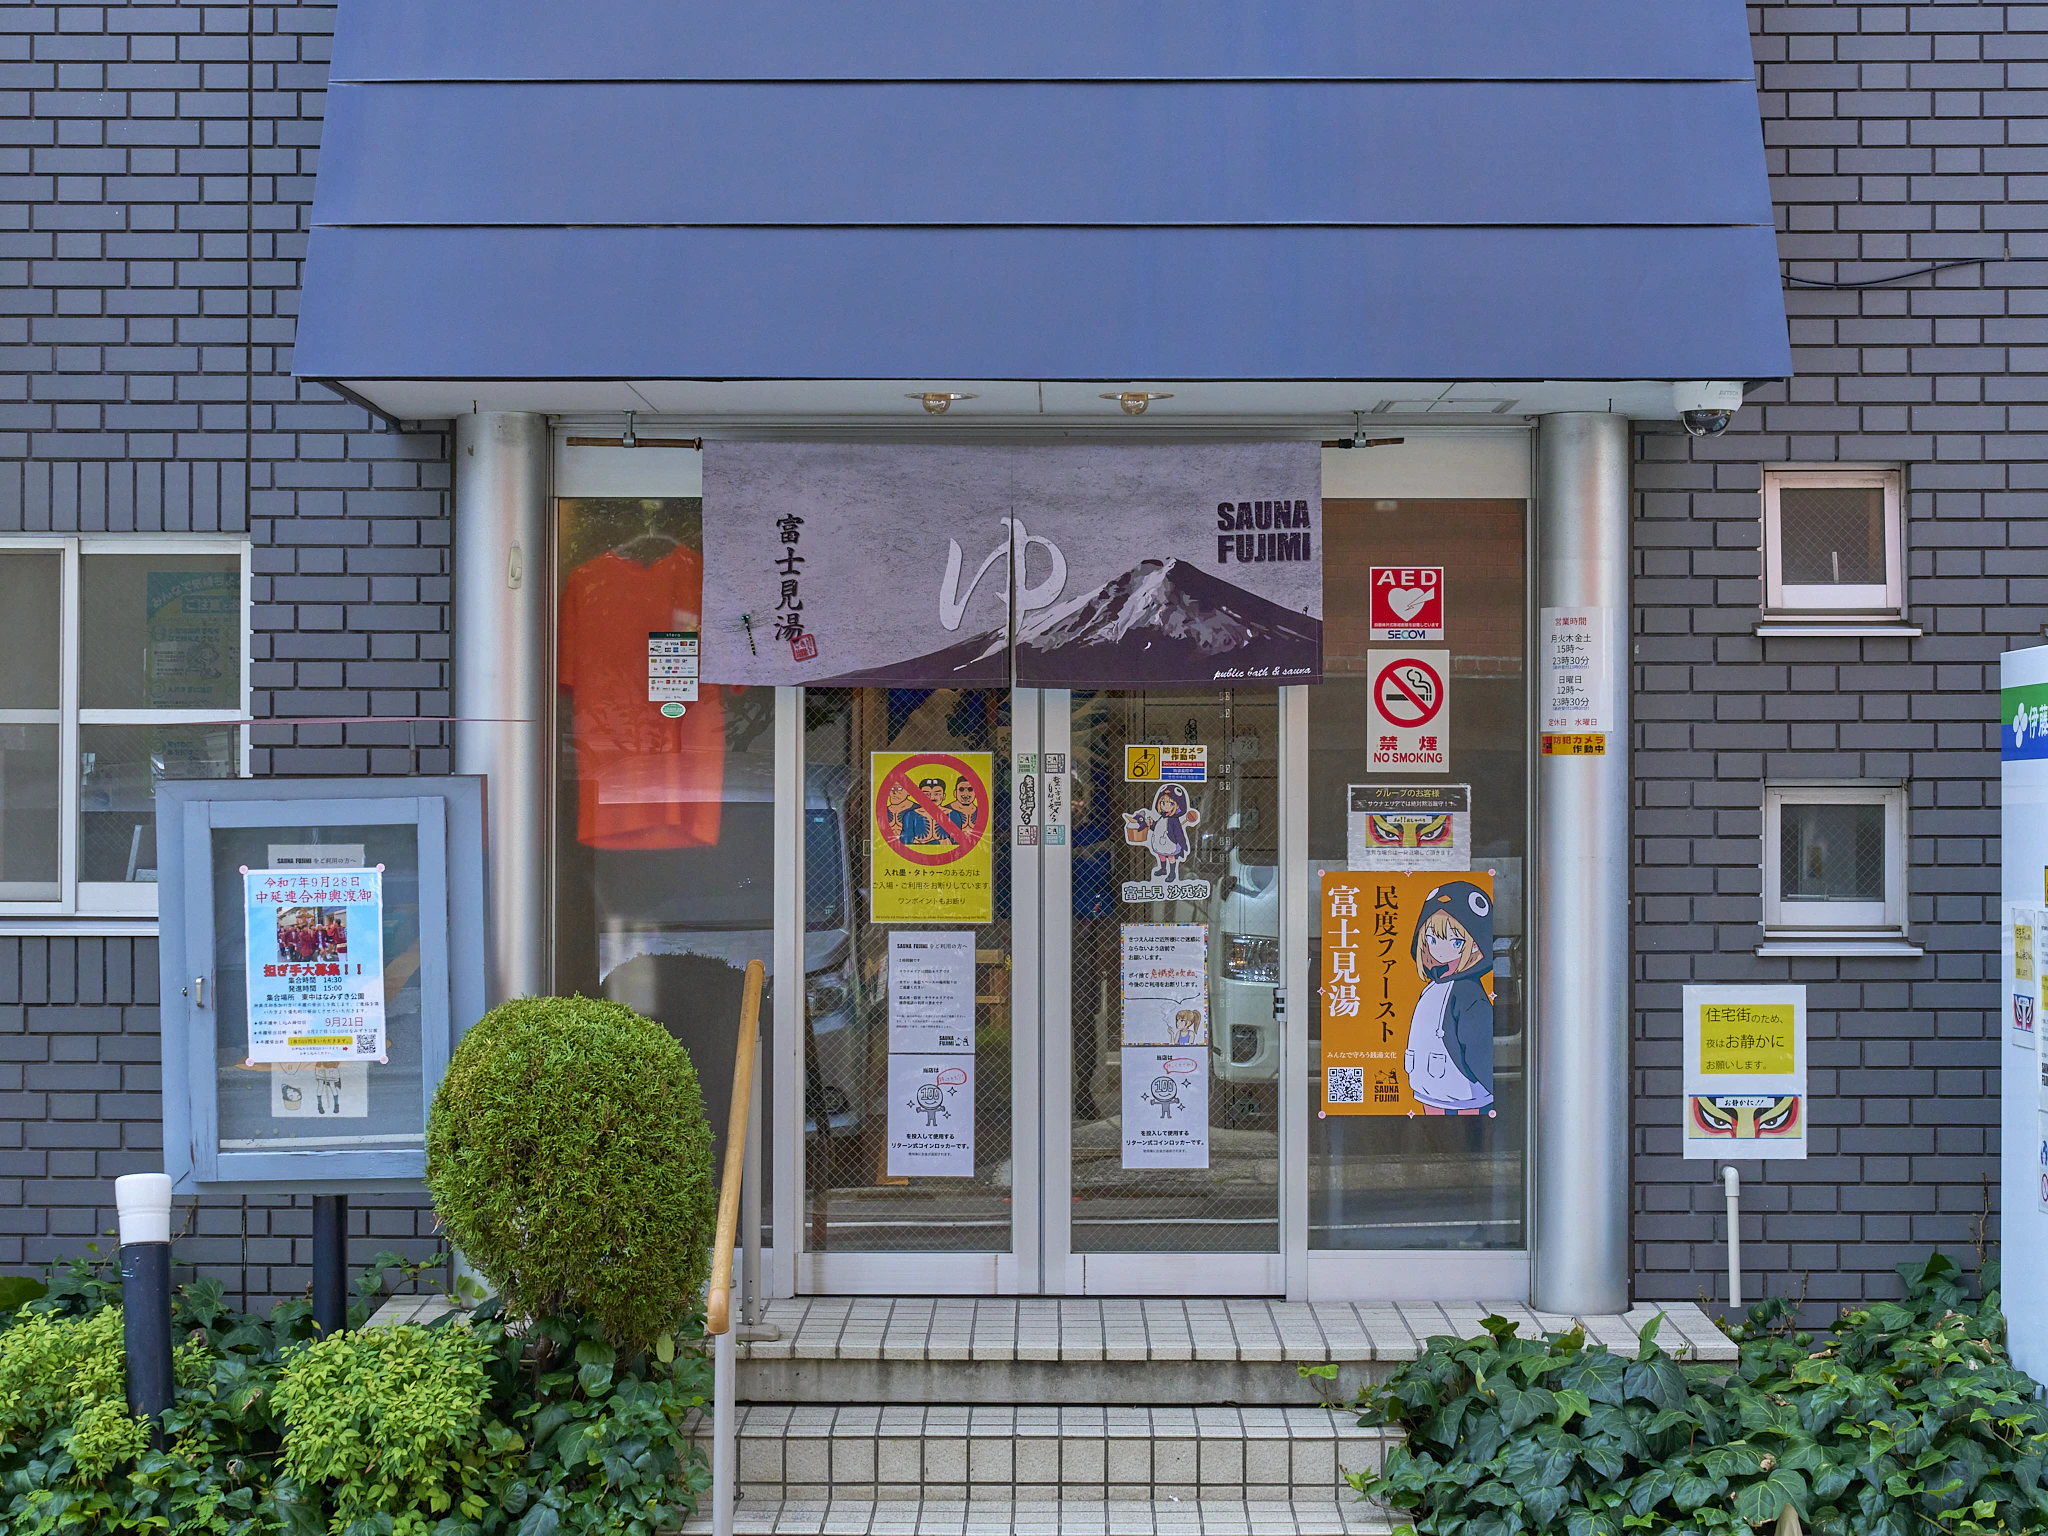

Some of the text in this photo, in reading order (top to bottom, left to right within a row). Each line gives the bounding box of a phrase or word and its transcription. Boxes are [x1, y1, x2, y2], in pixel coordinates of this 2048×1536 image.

[1217, 500, 1311, 531] SAUNA
[1217, 532, 1311, 564] FUJIMI
[774, 513, 805, 642] 富士見湯
[1376, 570, 1437, 586] AED
[1554, 617, 1587, 626] 営業時間
[1388, 630, 1426, 639] SECOM
[1550, 633, 1592, 644] 月火木金土
[1552, 656, 1590, 666] 23時30分
[1213, 667, 1244, 680] public
[1271, 666, 1280, 676] &
[1282, 667, 1312, 676] sauna
[1558, 675, 1582, 684] 日曜日
[1552, 698, 1590, 707] 23時30分
[1548, 718, 1598, 726] 定休日 水曜日
[1553, 736, 1604, 744] 防犯カメラ
[1572, 744, 1604, 753] 作動中
[1373, 752, 1443, 763] NO SMOKING
[1375, 789, 1440, 798] グループのお客様
[884, 868, 980, 877] 入れ墨・タトゥーのある方は
[264, 876, 360, 888] 令和7年9月28日
[255, 888, 372, 903] 中延連合神輿渡御
[1124, 885, 1163, 900] 富士見
[897, 897, 966, 905] ワンポイントもお断り
[1327, 885, 1361, 1018] 富士見湯
[1373, 885, 1398, 1043] 民度ファースト
[301, 993, 365, 1001] 東中はなみずき公園
[1705, 1007, 1784, 1023] 住宅街のため、
[325, 1017, 363, 1027] 9月21日
[1706, 1034, 1784, 1048] 夜はお静かに
[1327, 1051, 1397, 1059] みんなで守ろう銭湯文化
[1706, 1060, 1767, 1070] お願いします。
[1155, 1080, 1174, 1093] 100
[1374, 1085, 1399, 1093] SAUNA
[920, 1087, 940, 1100] 100
[1374, 1094, 1399, 1102] FUJIMI
